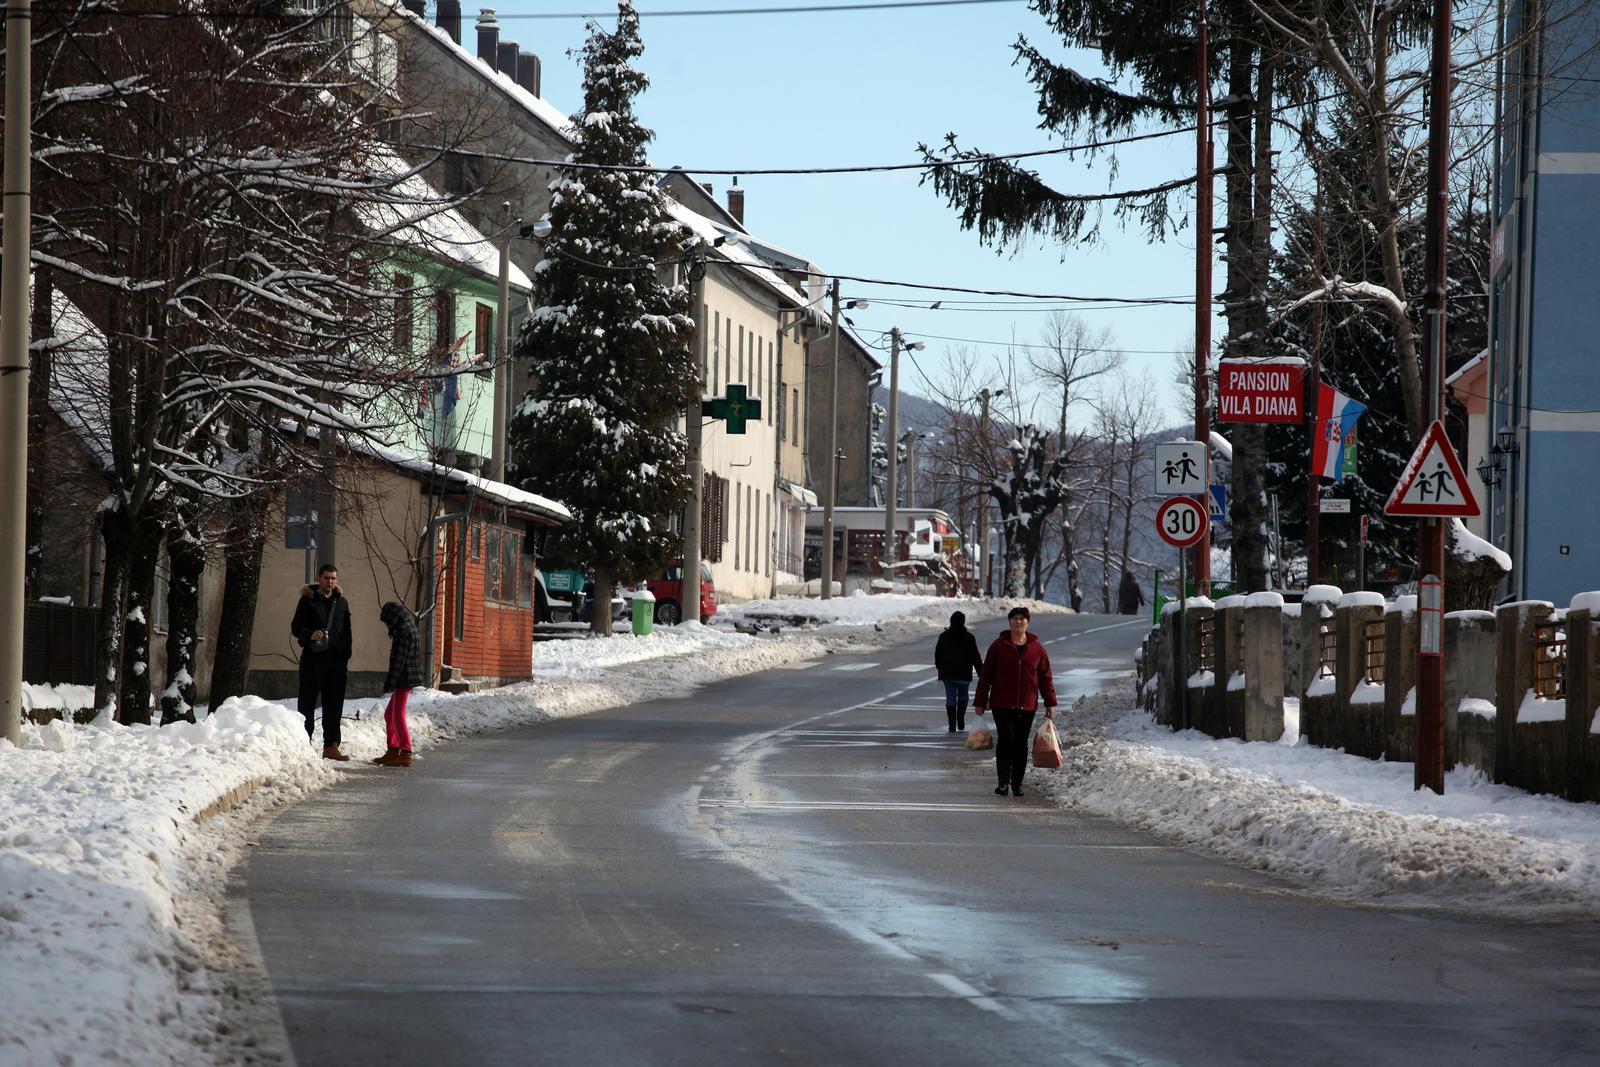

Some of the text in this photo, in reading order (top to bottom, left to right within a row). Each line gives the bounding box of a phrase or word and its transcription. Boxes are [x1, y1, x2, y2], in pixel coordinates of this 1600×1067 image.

[1230, 371, 1289, 391] PANSION
[1221, 395, 1297, 416] VILA DIANA
[1167, 509, 1195, 534] 30
